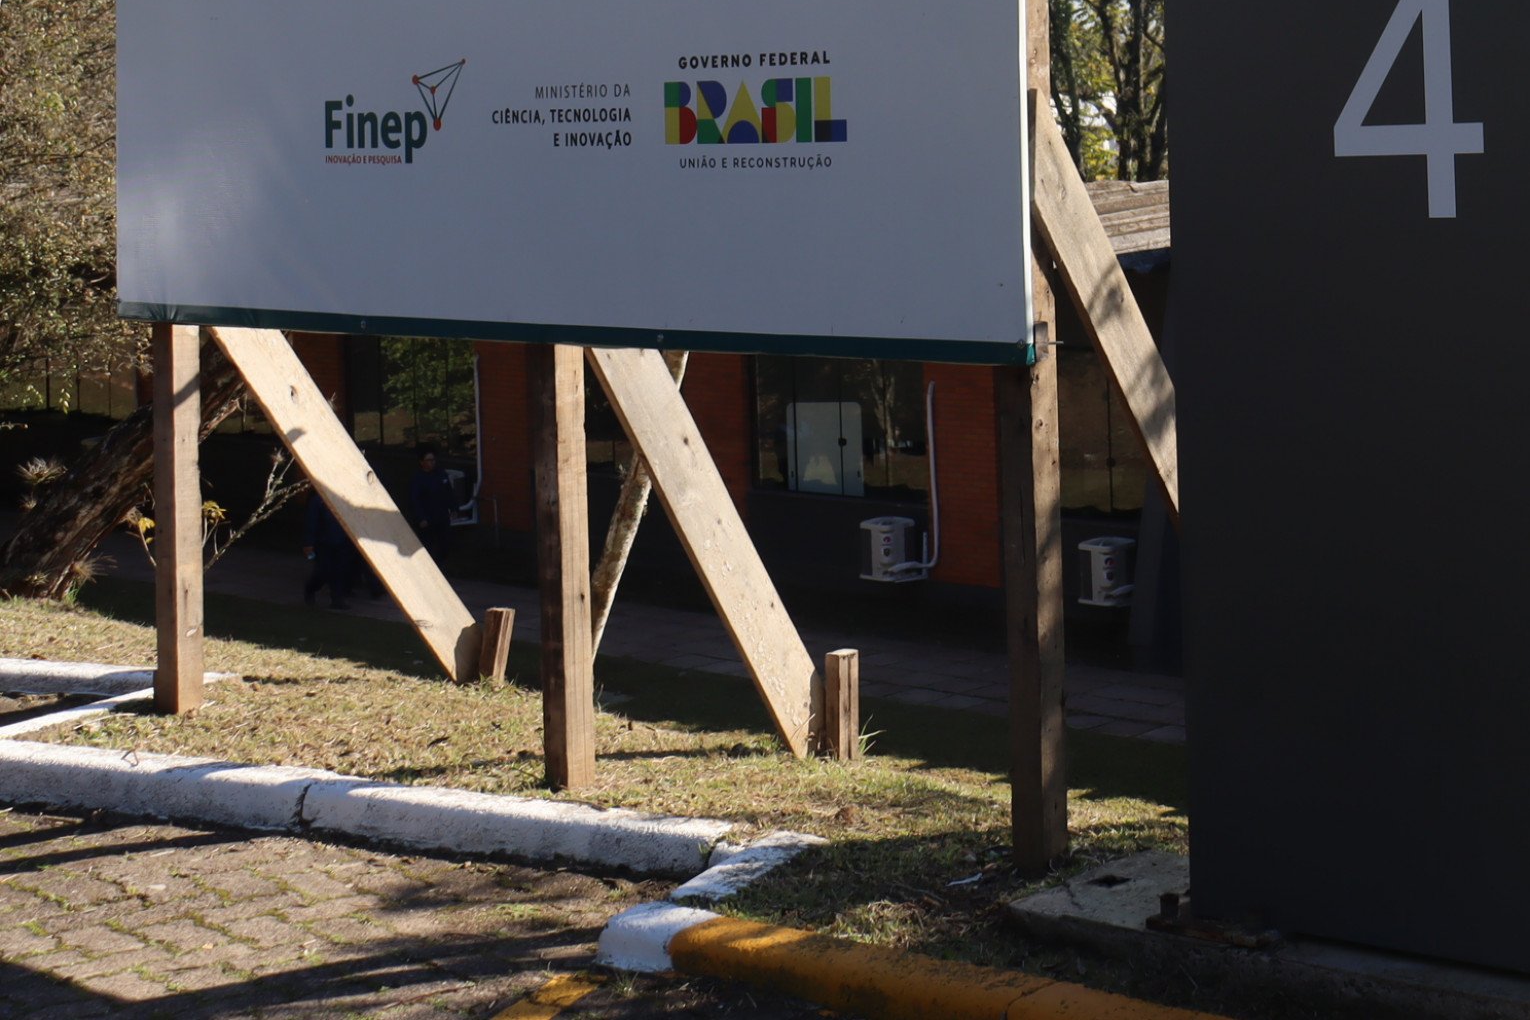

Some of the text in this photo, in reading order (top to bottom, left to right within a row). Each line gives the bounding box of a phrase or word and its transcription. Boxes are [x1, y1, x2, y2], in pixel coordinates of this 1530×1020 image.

[678, 50, 831, 70] GOVERNO FEDERAL
[535, 82, 631, 99] MINISTÉRIO DA
[491, 107, 632, 126] CIÊNCIA, TECNOLOGIA
[664, 76, 847, 144] BRASIL
[324, 94, 428, 164] Finep
[553, 130, 632, 150] E INOVAÇÃO
[325, 153, 362, 166] INOVAÇÃO
[369, 154, 402, 165] PESQUISA
[679, 155, 832, 170] UNIÃO E RECONSTRUÇÃO
